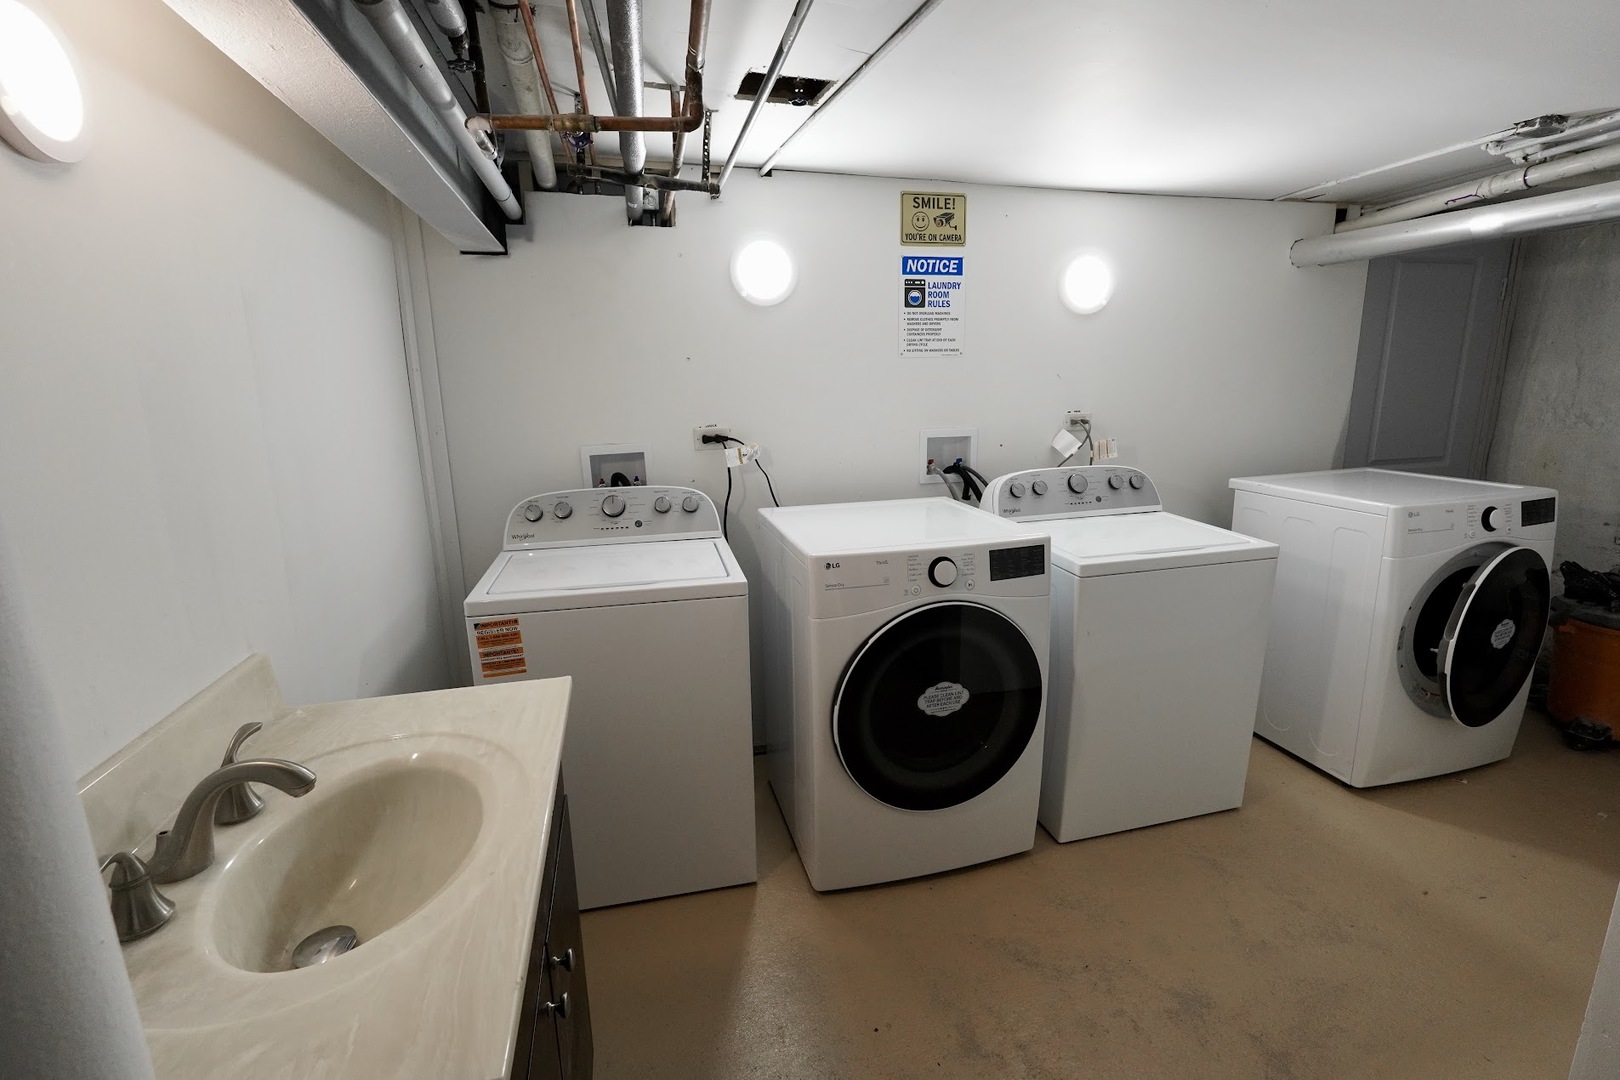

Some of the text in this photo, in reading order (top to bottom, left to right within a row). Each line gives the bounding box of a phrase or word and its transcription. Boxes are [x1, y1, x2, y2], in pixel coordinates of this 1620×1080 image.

[912, 196, 956, 210] SMILE!
[905, 233, 962, 242] YOU'RE ON CAMERA
[906, 259, 959, 273] NOTICE
[927, 281, 962, 290] LAUNDRY
[927, 291, 950, 299] ROOM
[927, 300, 951, 308] RULES
[511, 532, 535, 541] Whirlpool
